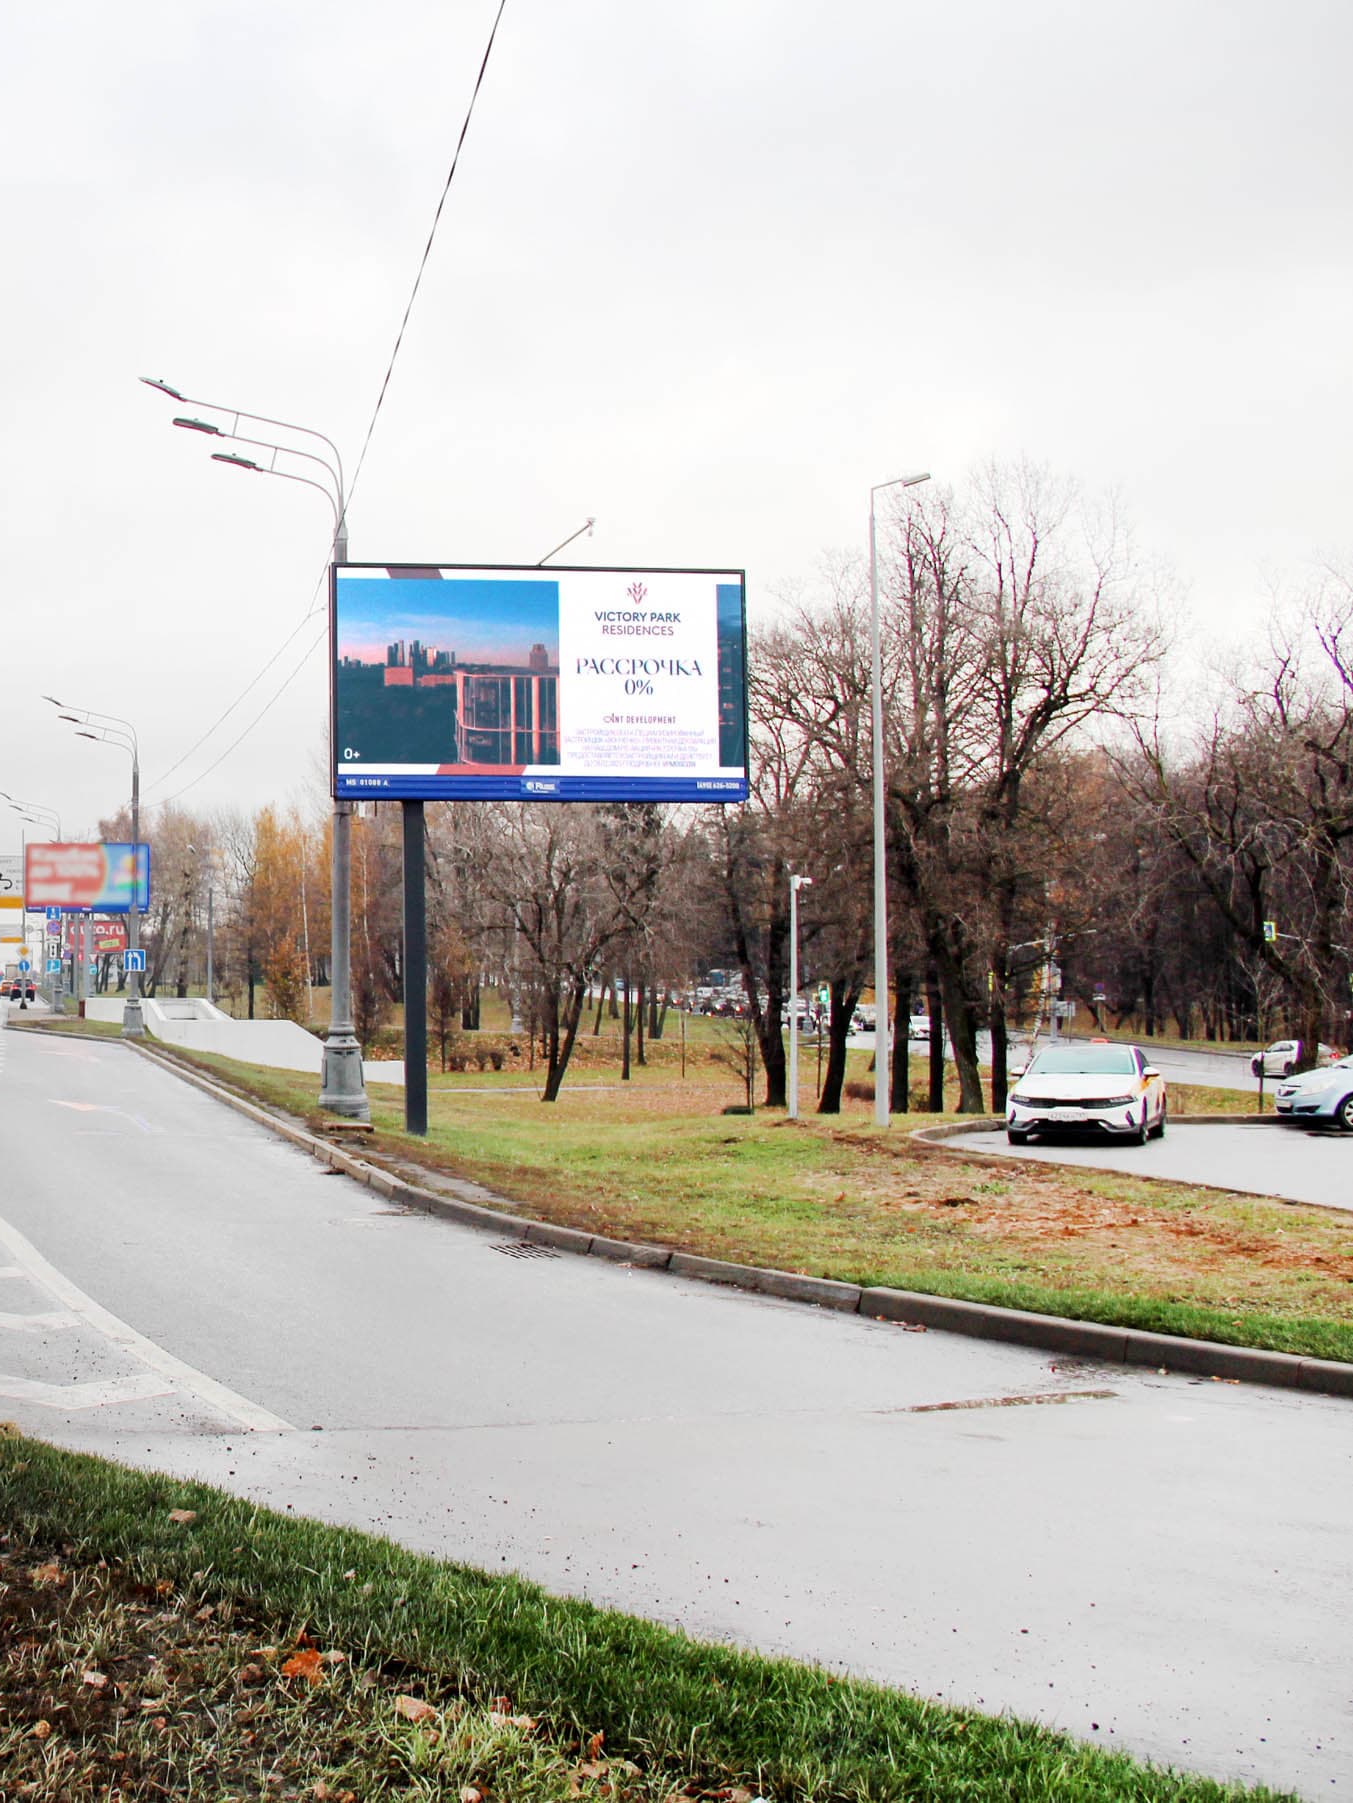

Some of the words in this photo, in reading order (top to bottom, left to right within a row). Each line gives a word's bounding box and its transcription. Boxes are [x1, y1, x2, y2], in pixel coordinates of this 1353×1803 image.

[595, 611, 647, 622] VICTORY
[650, 612, 681, 623] PARK
[602, 625, 674, 636] RESIDENCES
[576, 658, 703, 676] РАССРОЧКА
[624, 679, 654, 695] 0%
[626, 715, 676, 724] DEVELOPMENT
[344, 747, 361, 760] 0+
